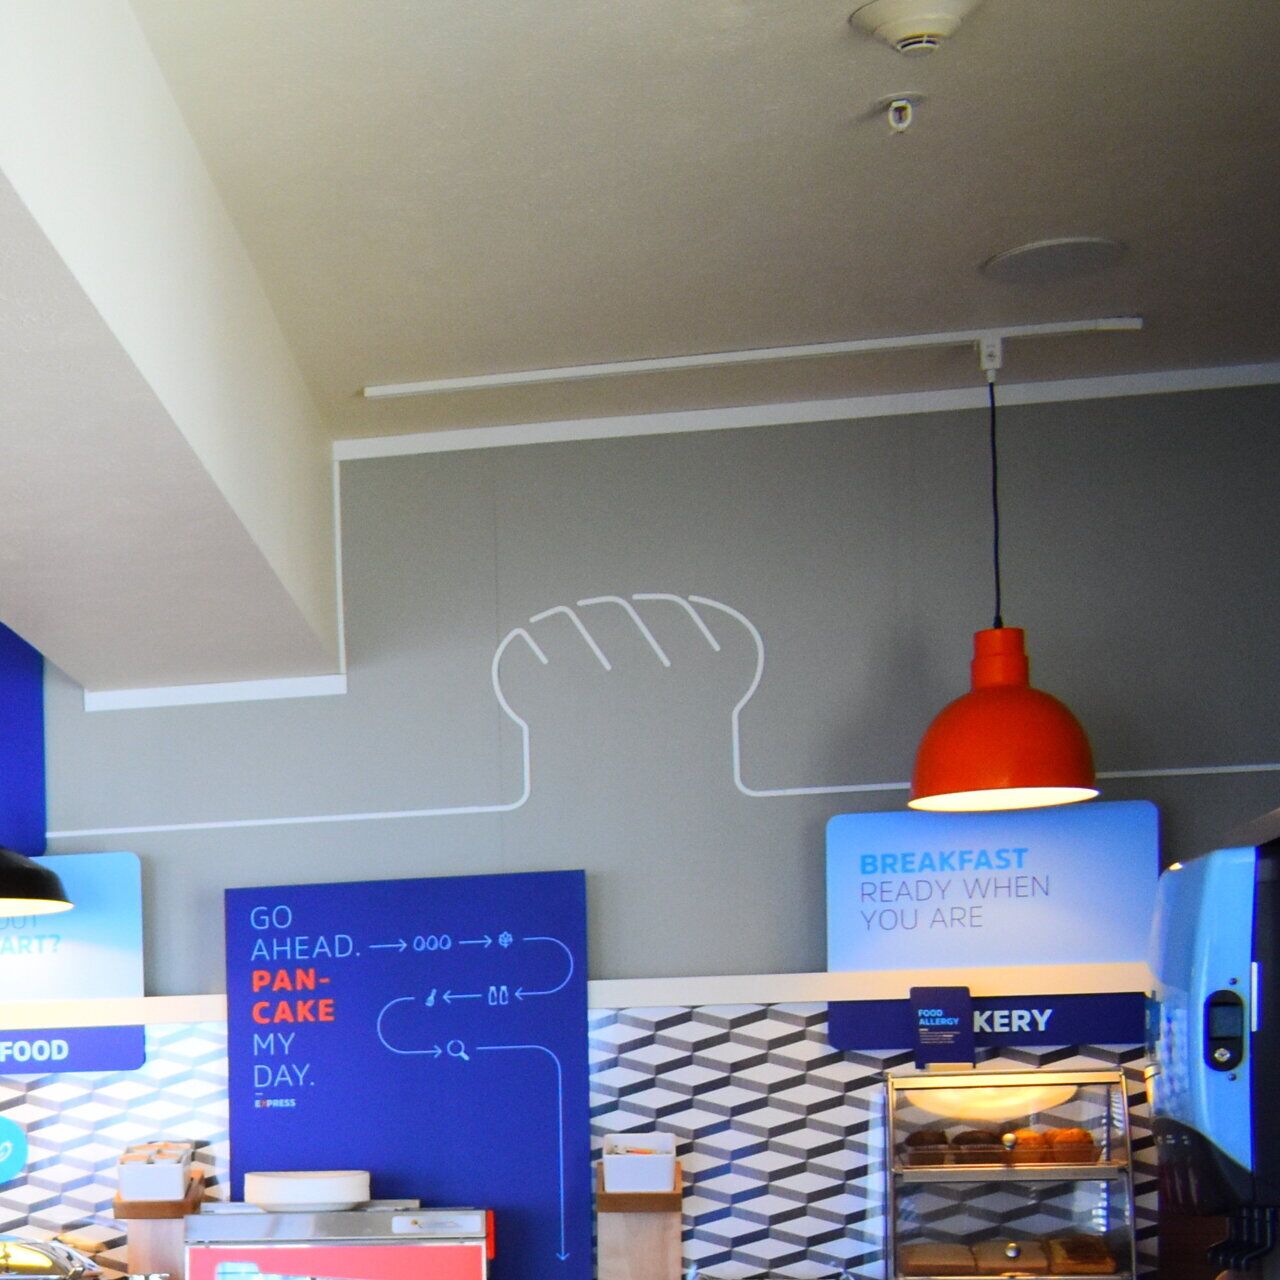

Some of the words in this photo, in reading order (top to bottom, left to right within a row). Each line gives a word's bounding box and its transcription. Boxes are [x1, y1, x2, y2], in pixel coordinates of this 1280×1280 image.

[860, 847, 1029, 875] BREAKFAST
[861, 879, 952, 903] READY
[963, 875, 1050, 900] WHEN
[250, 905, 292, 930] GO
[861, 909, 918, 931] YOU
[930, 905, 983, 929] ARE
[250, 934, 361, 962] AHEAD.
[252, 967, 331, 993] PAN-
[251, 998, 335, 1024] CAKE
[918, 1008, 943, 1017] FOOD
[919, 1017, 960, 1026] ALLERGY
[973, 1009, 1052, 1033] KERY
[253, 1032, 296, 1056] MY
[253, 1063, 315, 1088] DAY.
[254, 1098, 296, 1108] EXPRESS
